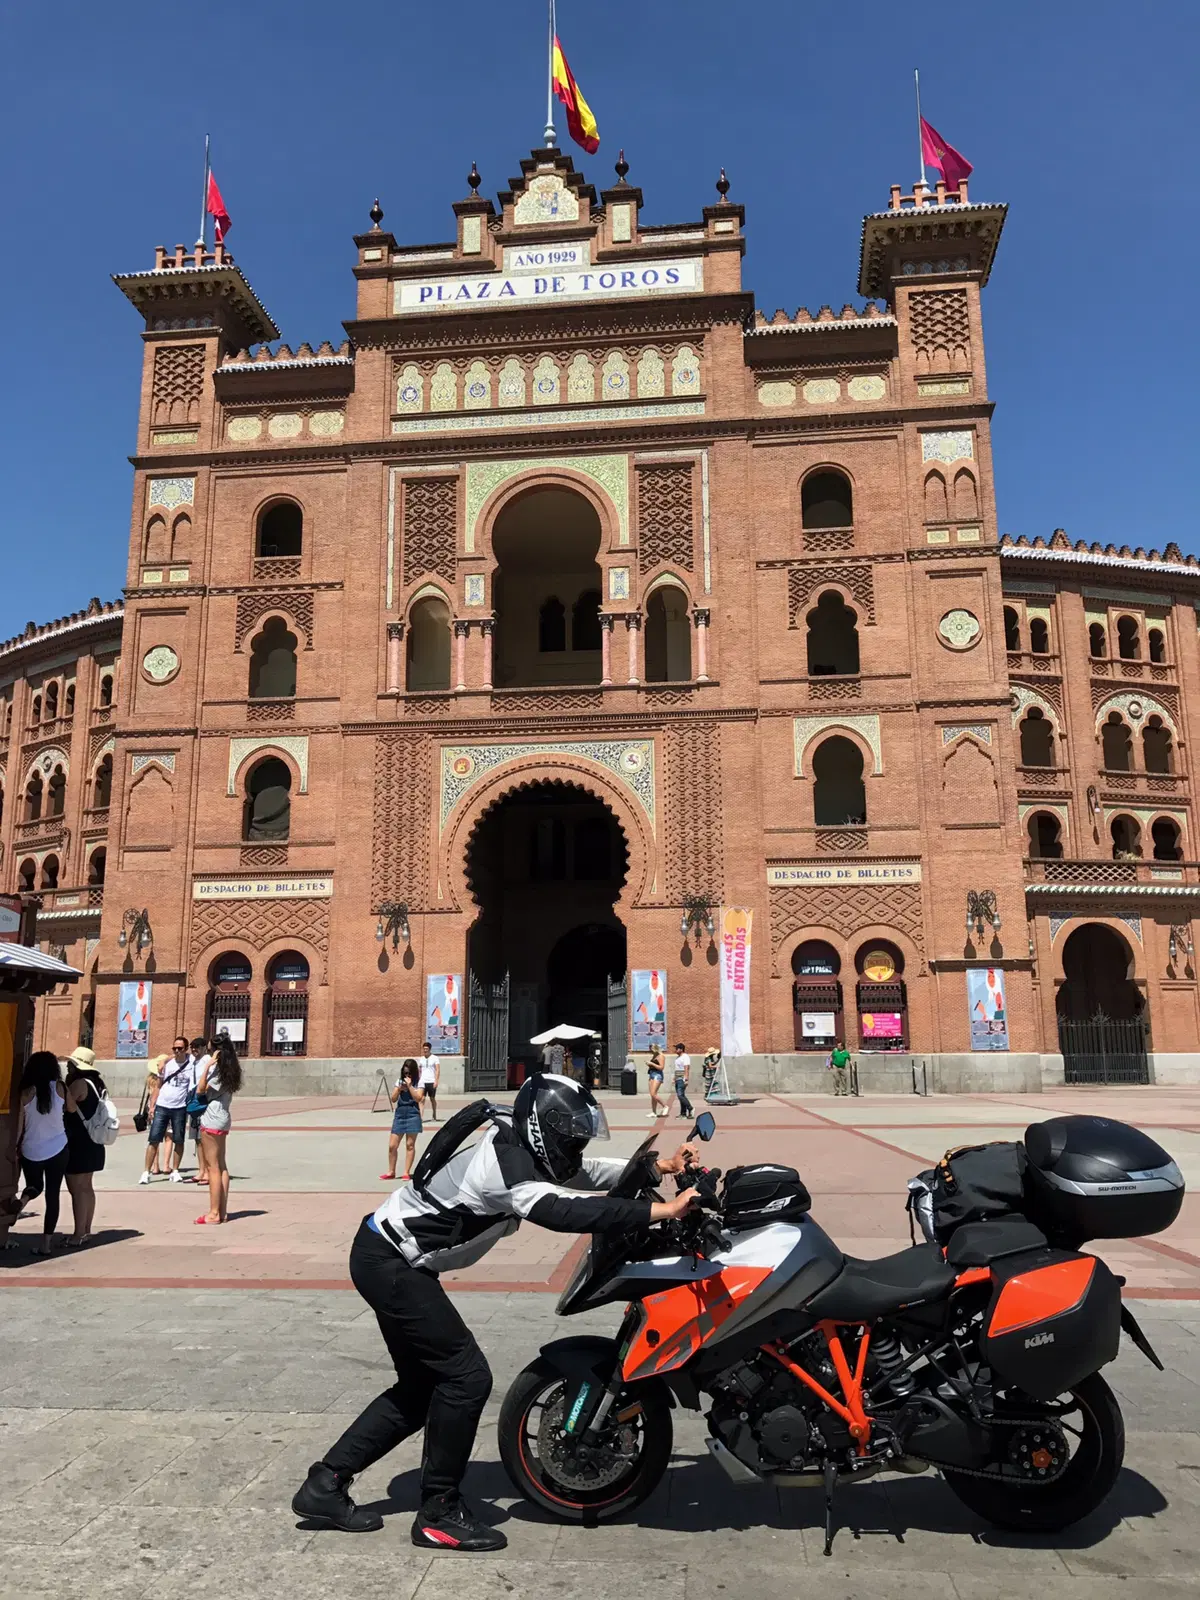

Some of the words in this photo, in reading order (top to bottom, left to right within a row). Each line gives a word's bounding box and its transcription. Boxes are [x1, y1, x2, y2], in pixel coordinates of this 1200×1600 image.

[514, 250, 545, 266] AÑO
[547, 250, 577, 264] 1929
[418, 280, 517, 303] PLAZA
[534, 276, 566, 294] DE
[578, 267, 681, 290] TOROS
[774, 870, 831, 879] DESPACHO
[836, 870, 852, 878] DE
[858, 868, 913, 878] BILLETES
[199, 884, 252, 893] DESPACHO
[256, 884, 270, 892] DE
[275, 882, 326, 892] BILLETES
[724, 933, 734, 981] TICKETS
[733, 927, 747, 991] ENTRADAS
[1024, 1332, 1055, 1349] KTM
